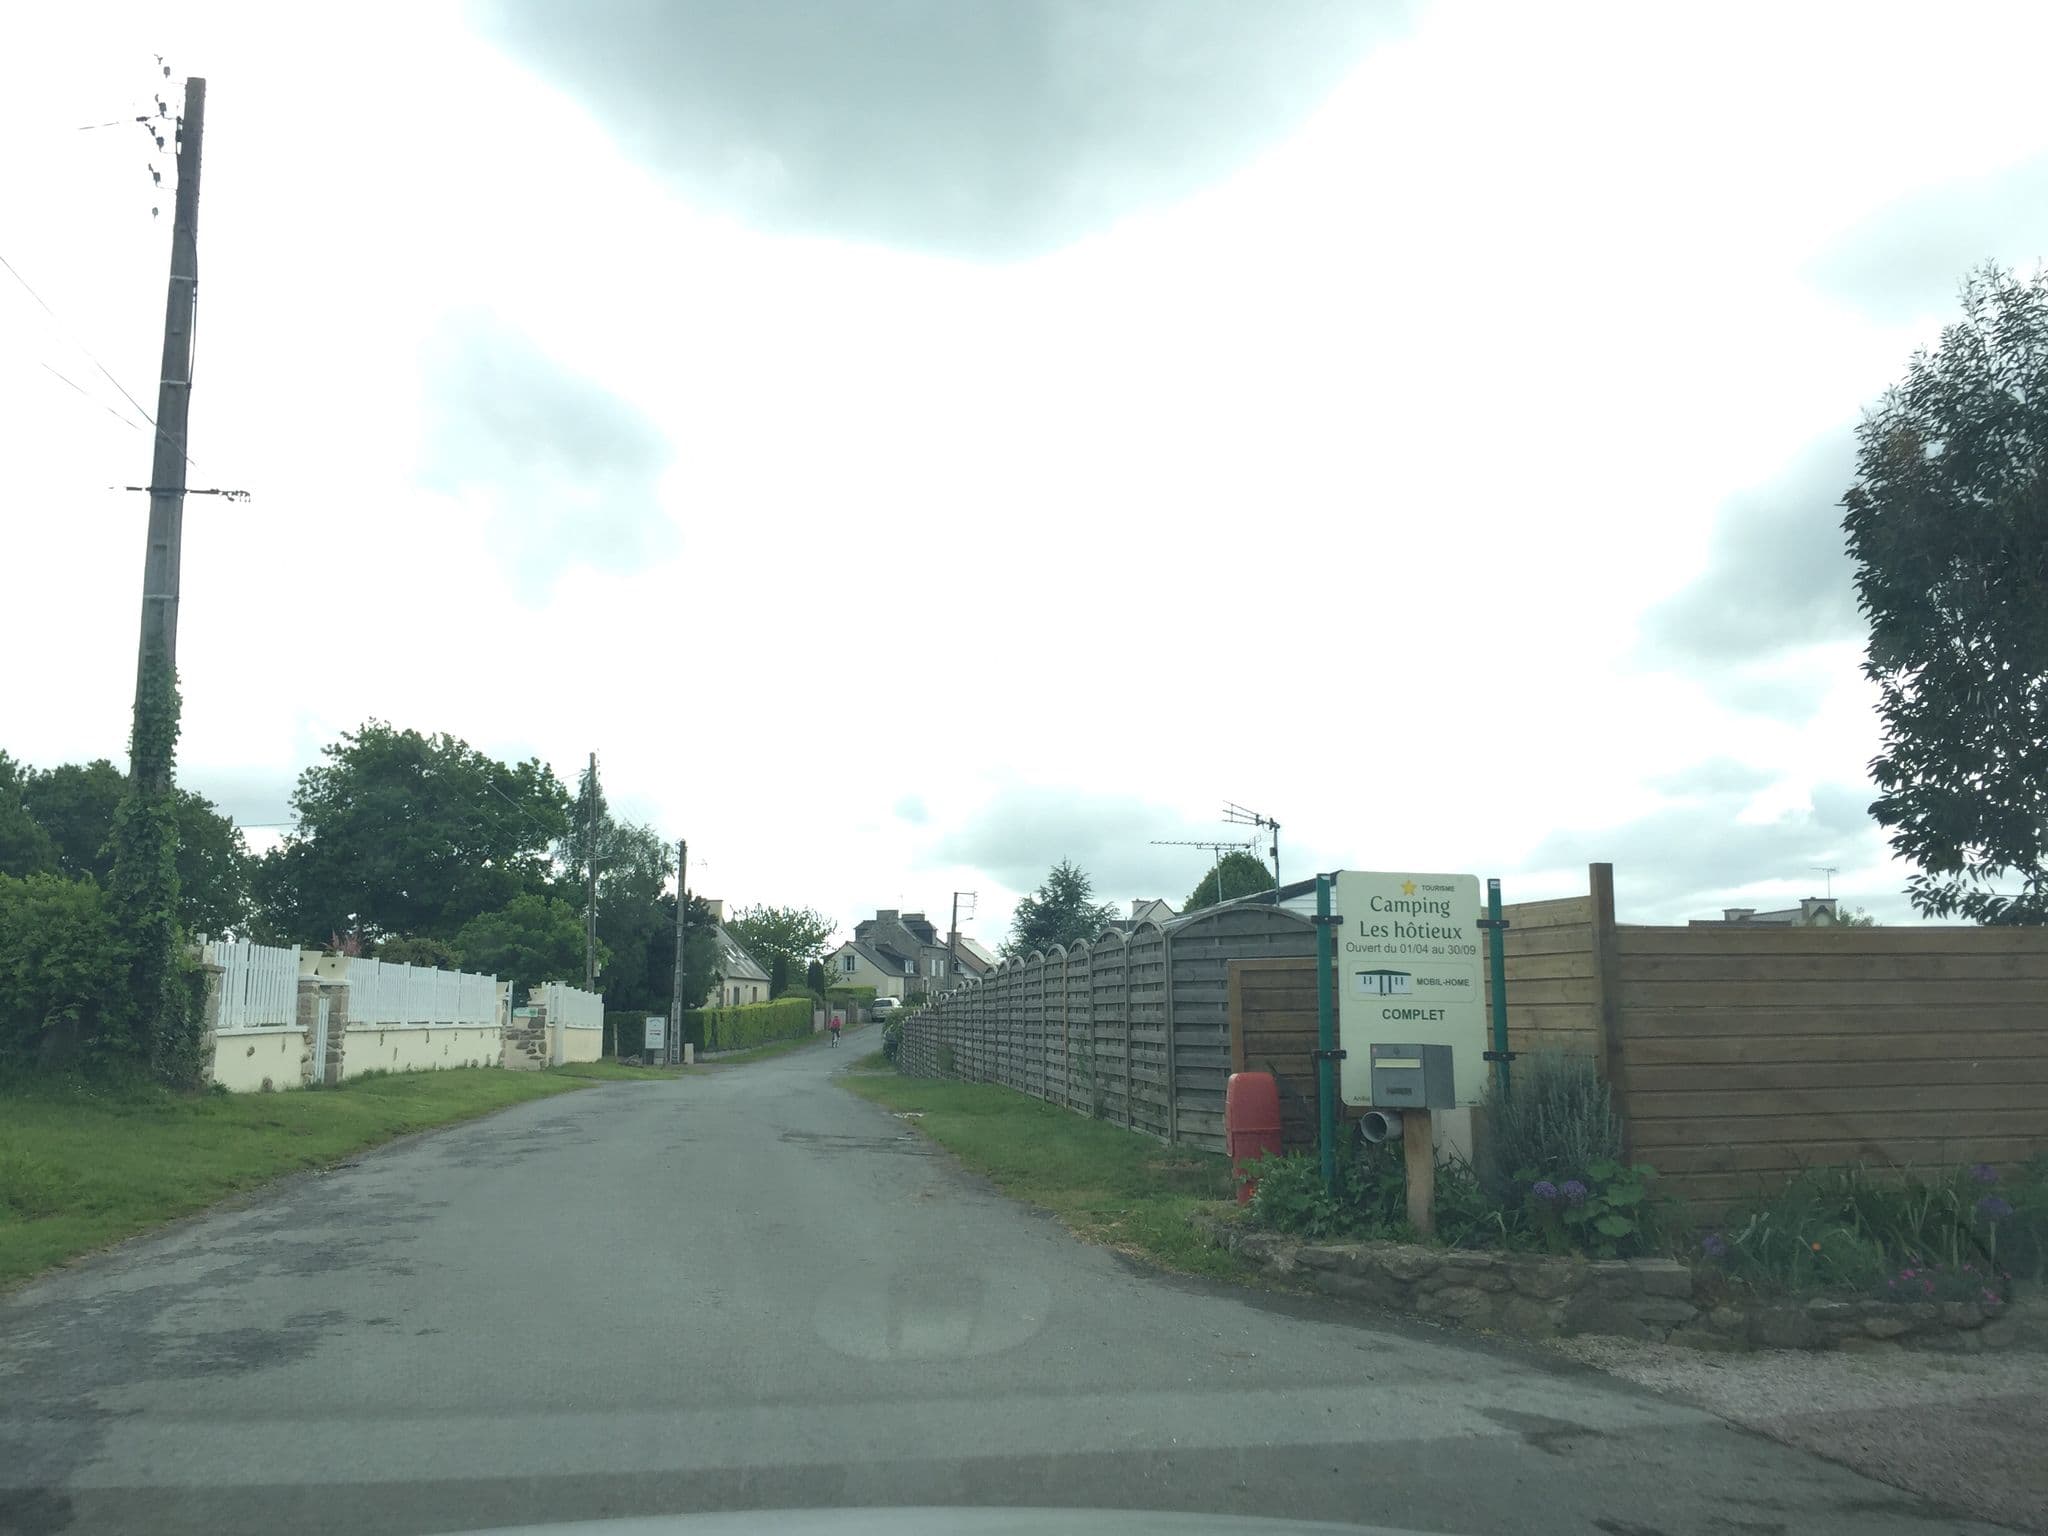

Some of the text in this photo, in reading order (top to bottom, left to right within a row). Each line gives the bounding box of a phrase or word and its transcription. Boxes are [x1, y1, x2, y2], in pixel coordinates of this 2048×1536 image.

[1370, 896, 1450, 918] Camping
[1360, 920, 1462, 939] Les hôtieux
[1346, 942, 1477, 955] Ouvert du 01/04 au 30/09
[1416, 978, 1470, 986] MOBIL-HOME
[1382, 1008, 1445, 1020] COMPLET
